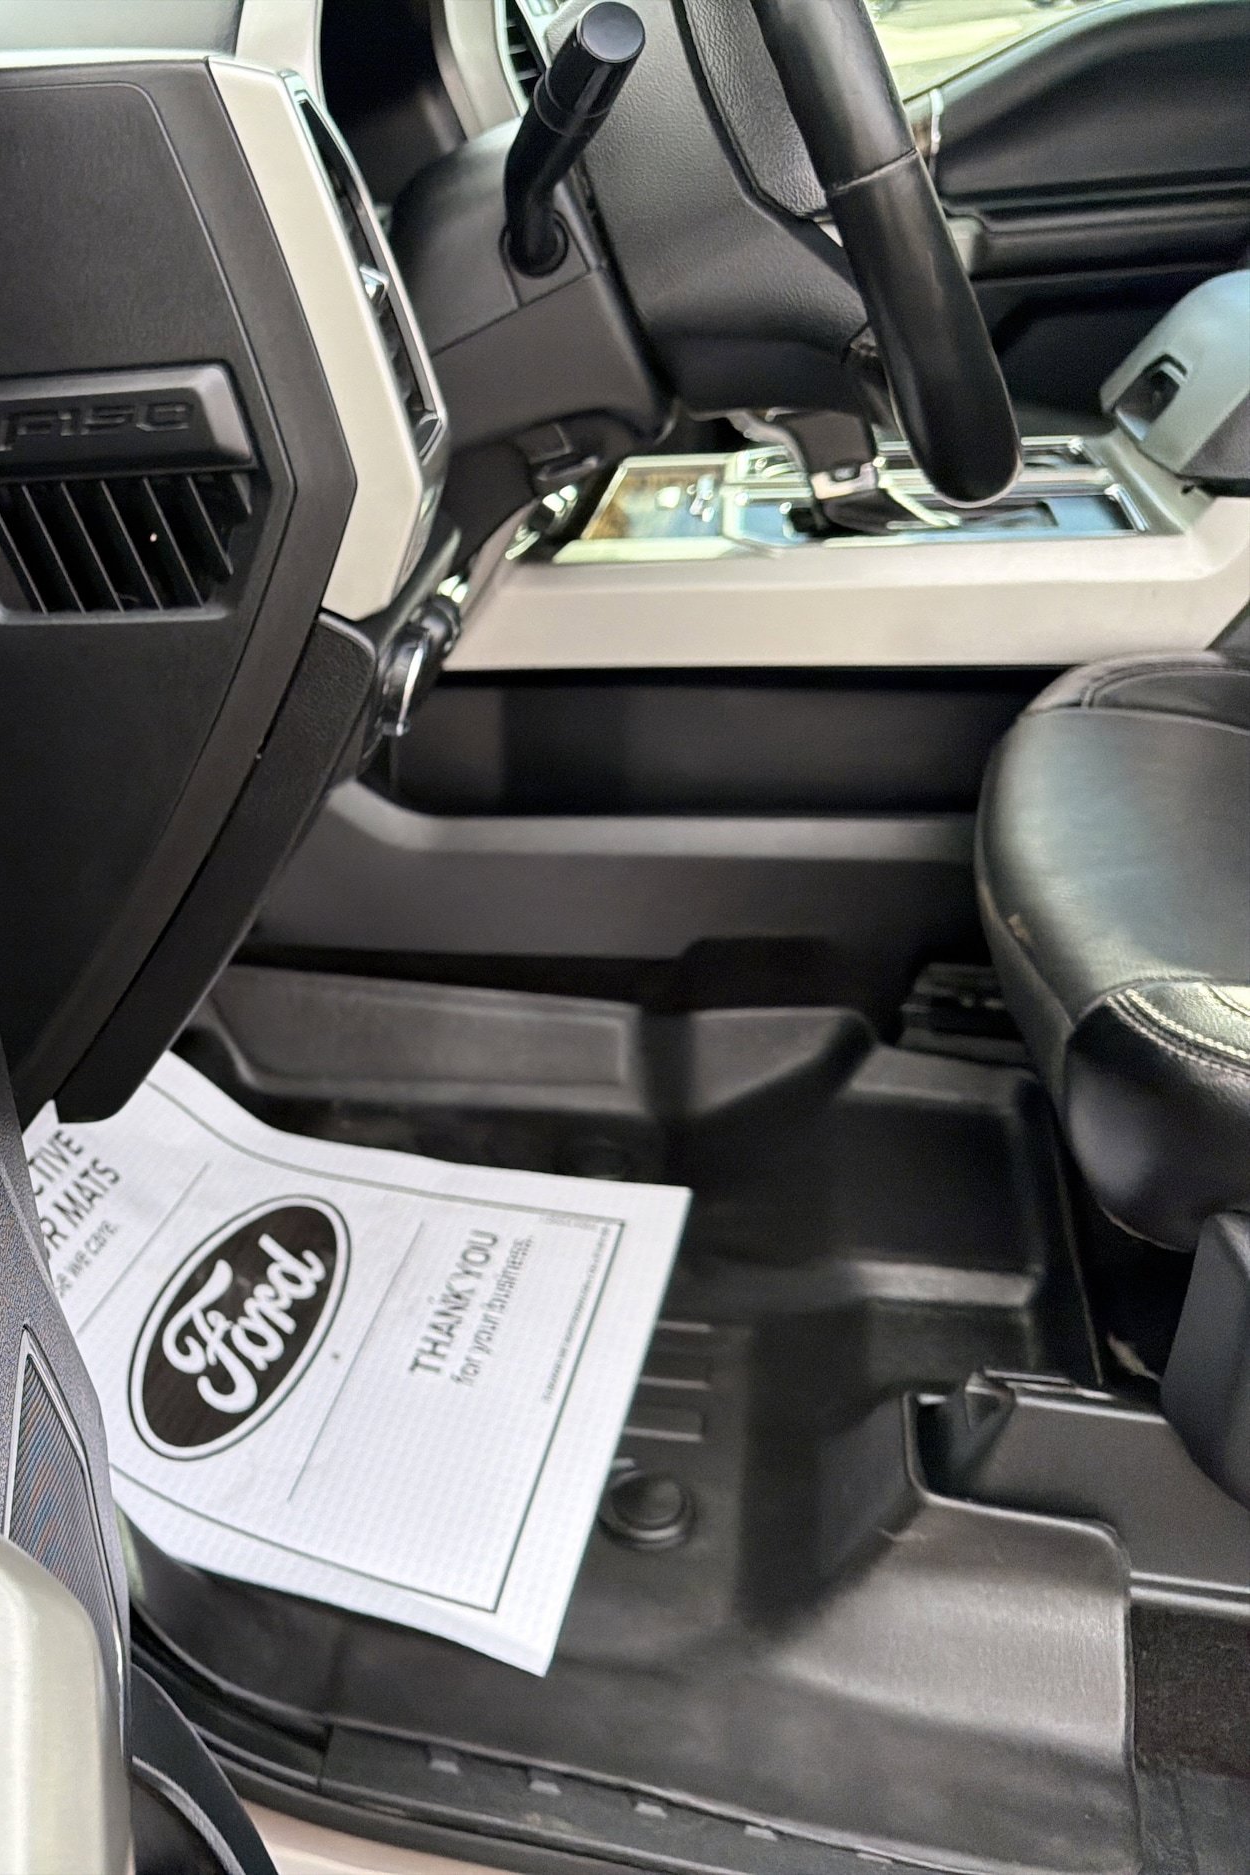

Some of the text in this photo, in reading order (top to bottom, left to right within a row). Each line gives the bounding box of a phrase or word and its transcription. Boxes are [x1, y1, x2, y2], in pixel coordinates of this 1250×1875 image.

[52, 1157, 120, 1228] MATS
[162, 1233, 326, 1413] Ford
[409, 1229, 499, 1374] THANK YOU
[450, 1356, 483, 1387] for
[469, 1312, 501, 1355] your
